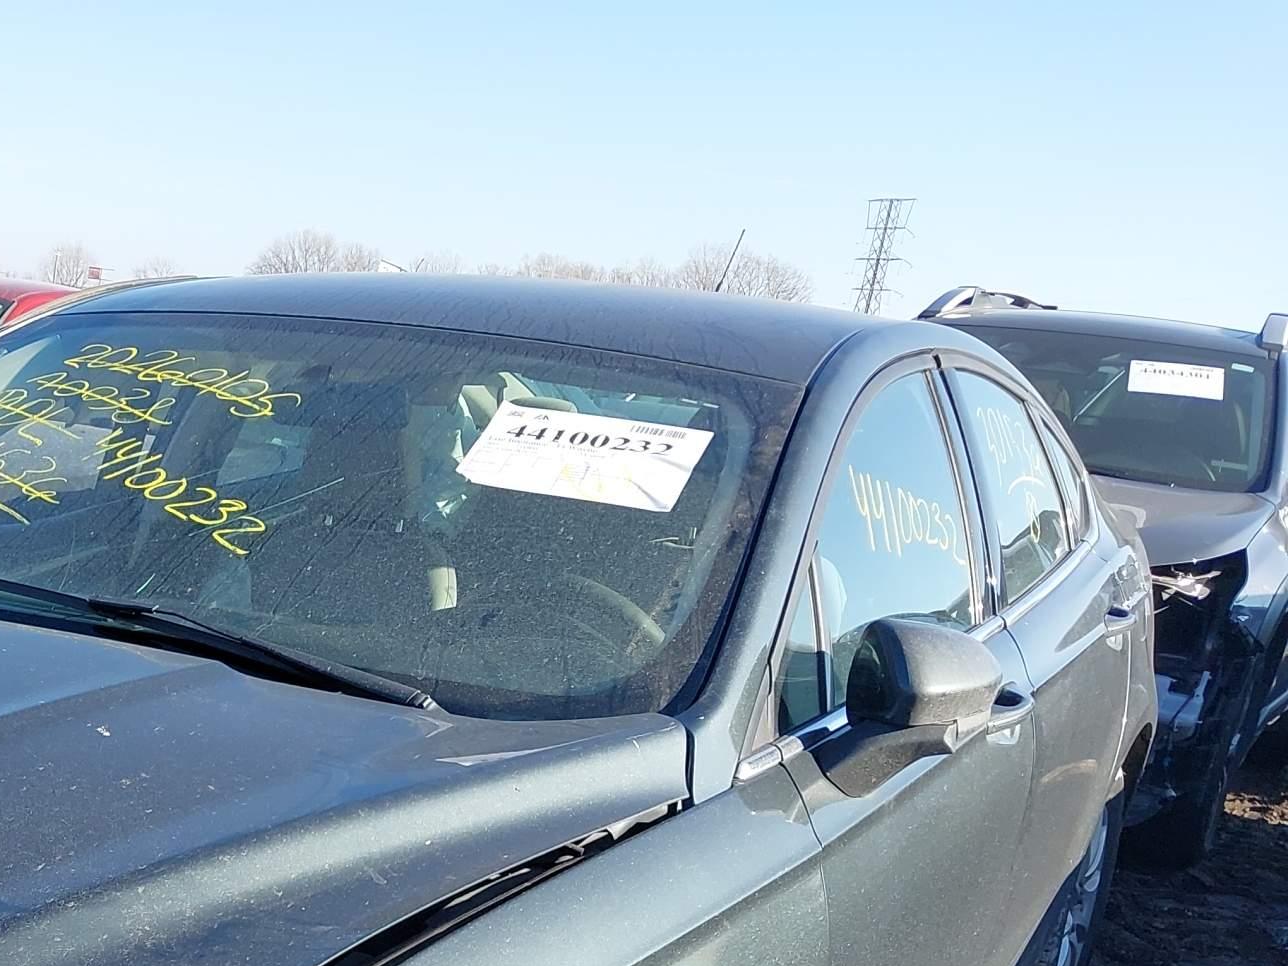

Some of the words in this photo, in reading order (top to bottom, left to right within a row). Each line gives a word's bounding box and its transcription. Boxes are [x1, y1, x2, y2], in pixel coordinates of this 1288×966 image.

[83, 427, 266, 555] 44100232
[506, 424, 674, 457] 44100232
[849, 463, 966, 565] 44100232
